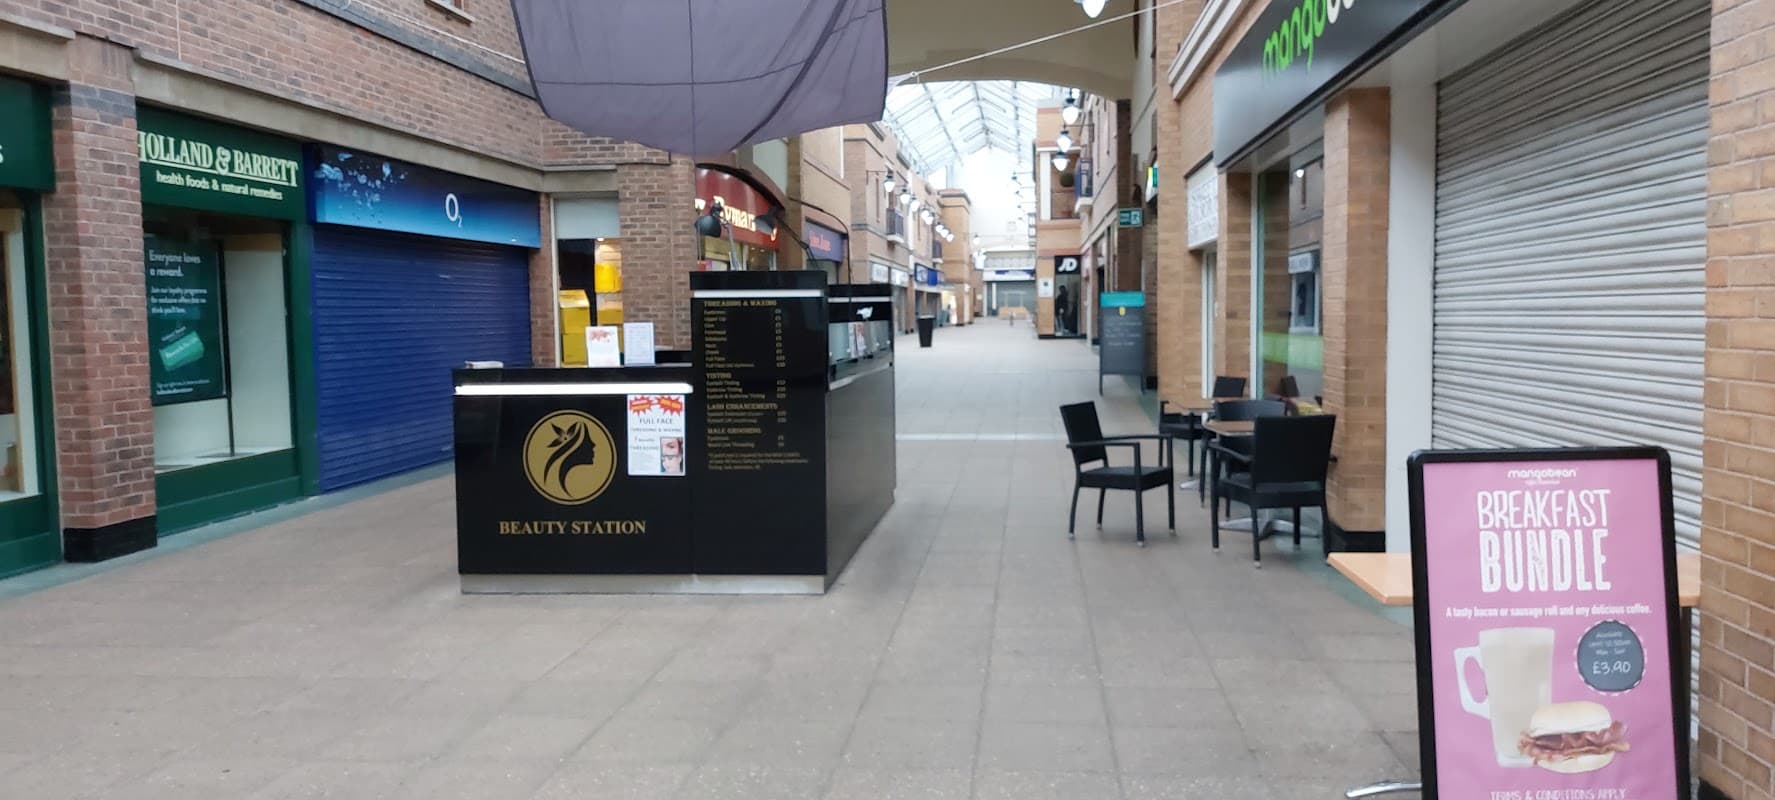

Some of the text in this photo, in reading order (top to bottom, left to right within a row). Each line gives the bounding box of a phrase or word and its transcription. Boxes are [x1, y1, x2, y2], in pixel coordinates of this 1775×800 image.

[215, 146, 231, 175] &
[233, 150, 298, 187] BARRETT
[156, 169, 283, 200] health foods & natural remedies
[1058, 257, 1077, 272] JD
[1477, 489, 1612, 529] BREAKFAST
[499, 520, 647, 535] BEAUTY STATION
[1479, 528, 1612, 592] BUNDLE
[1445, 607, 1452, 617] A
[1453, 607, 1473, 620] tasty
[1473, 606, 1498, 617] bacon
[1499, 607, 1509, 617] or
[1510, 607, 1543, 619] sausage
[1559, 604, 1574, 616] and
[1575, 606, 1590, 617] any
[1591, 604, 1625, 615] delicious
[1626, 603, 1653, 614] coffee.
[1592, 660, 1632, 675] £3.90
[1490, 790, 1522, 800] TERMS
[1535, 789, 1595, 800] CONDITIONS
[1597, 788, 1627, 800] APPLY
